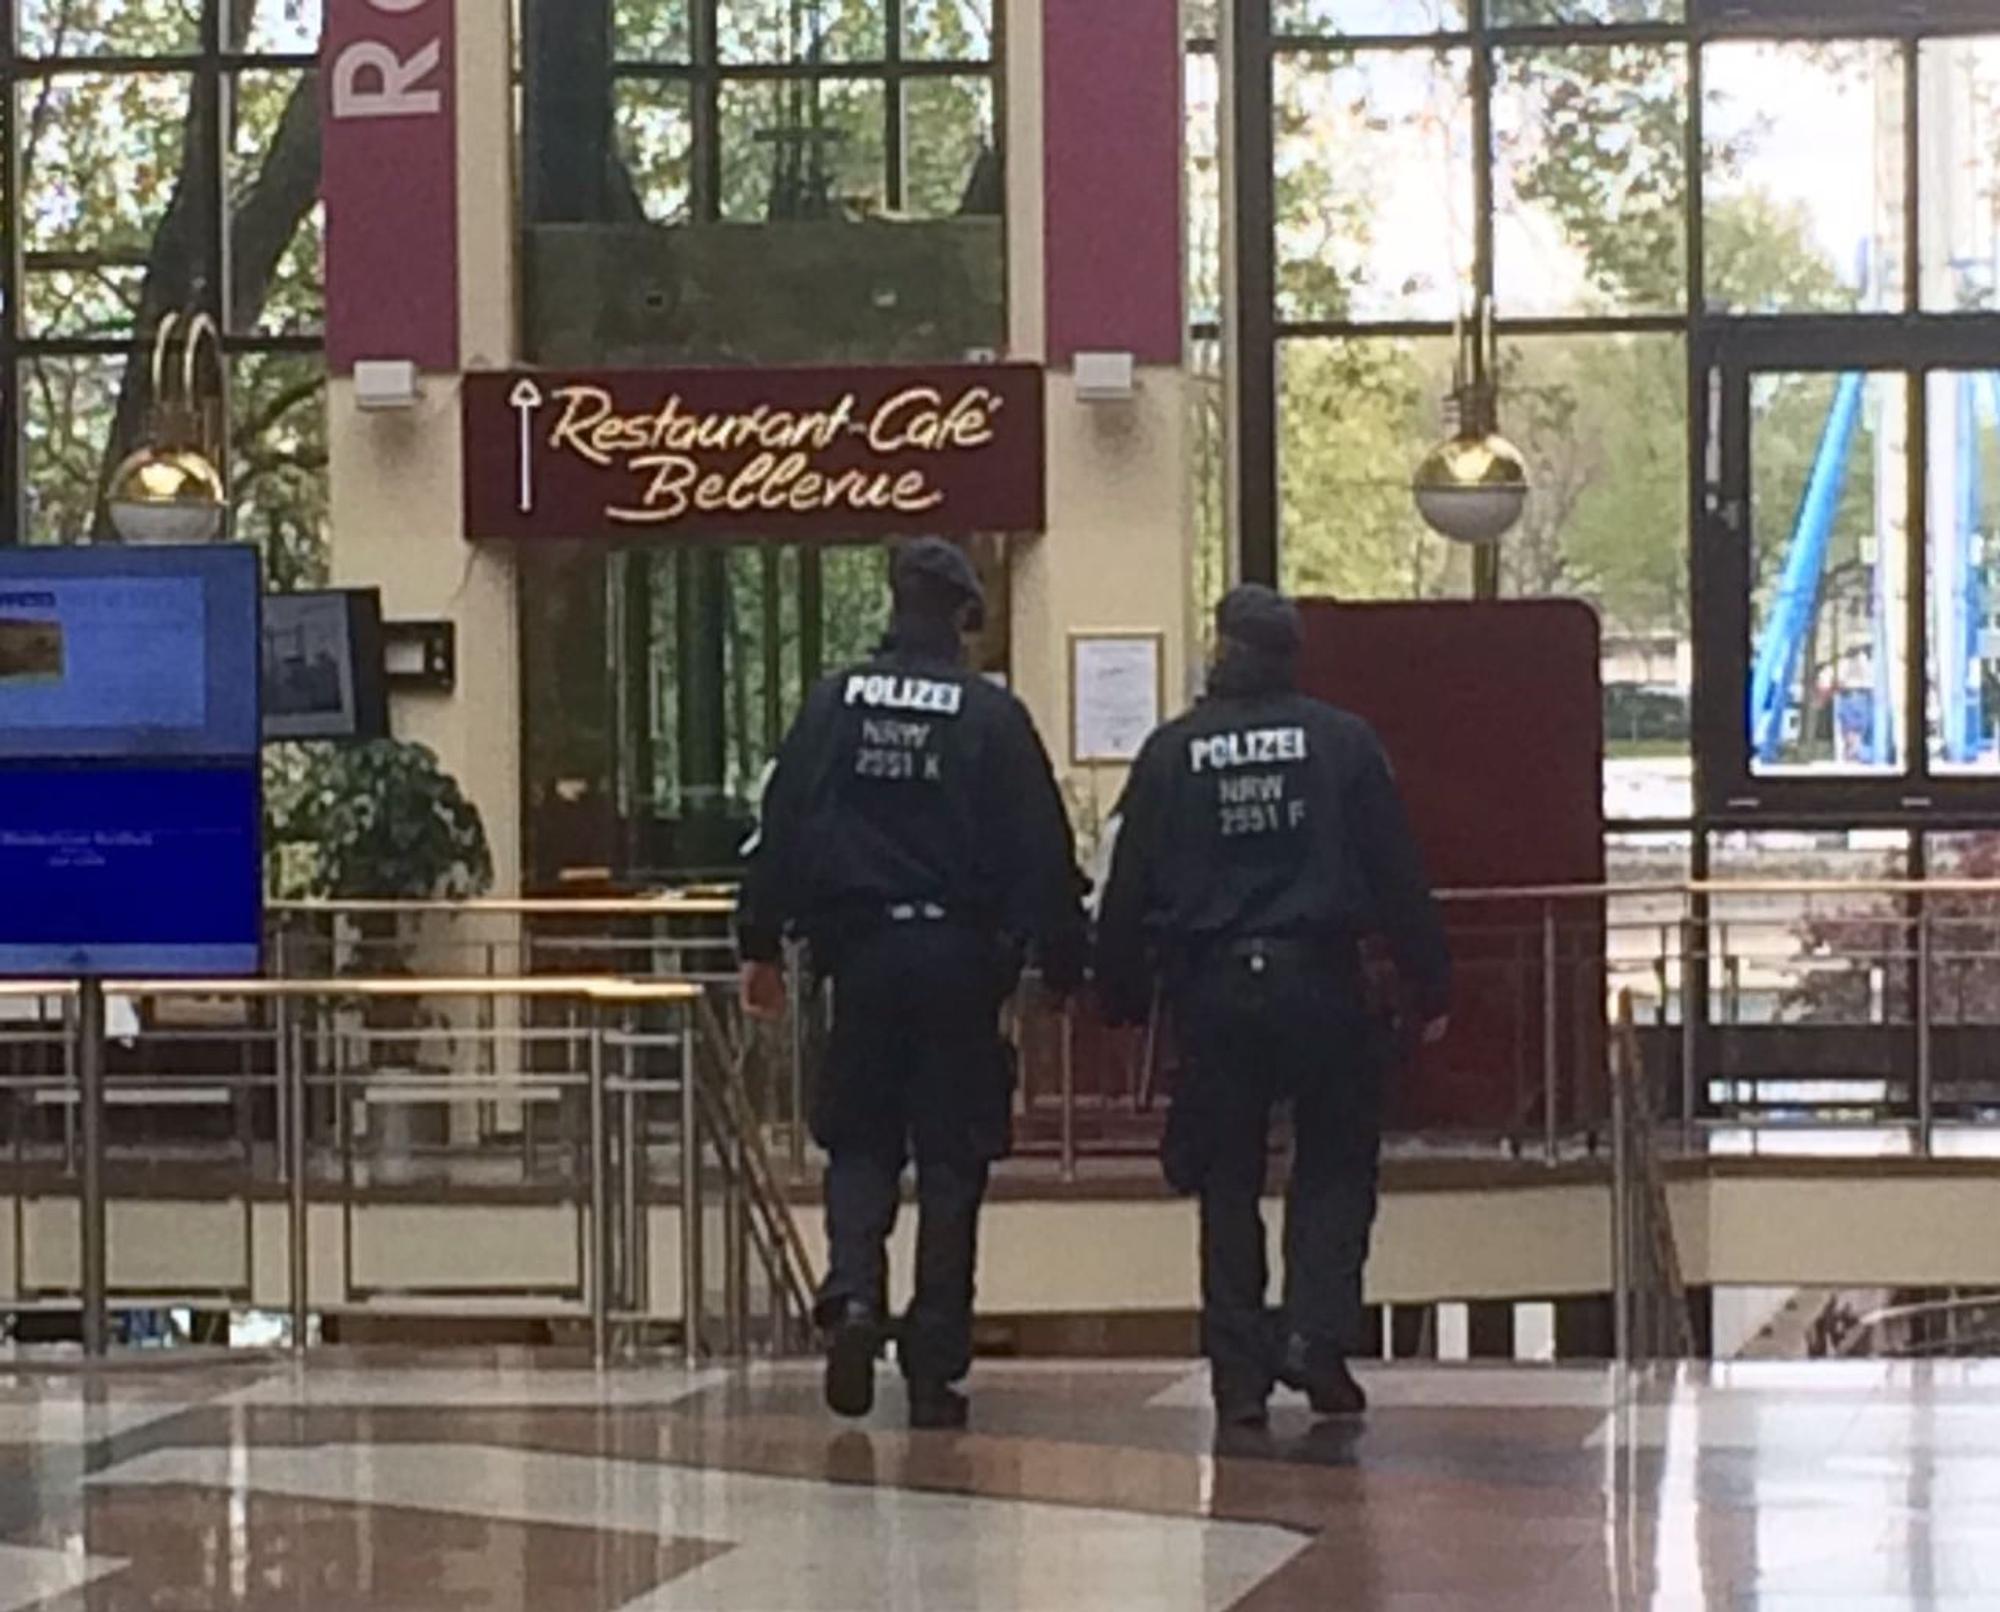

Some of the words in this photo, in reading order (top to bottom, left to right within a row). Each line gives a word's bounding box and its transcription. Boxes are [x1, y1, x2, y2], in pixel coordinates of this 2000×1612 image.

[332, 0, 441, 118] R
[606, 455, 942, 521] Bellevue
[844, 675, 962, 714] POLIZEI
[863, 718, 931, 748] NRW
[1190, 726, 1306, 773] POLIZEI
[1219, 774, 1284, 803] NRW
